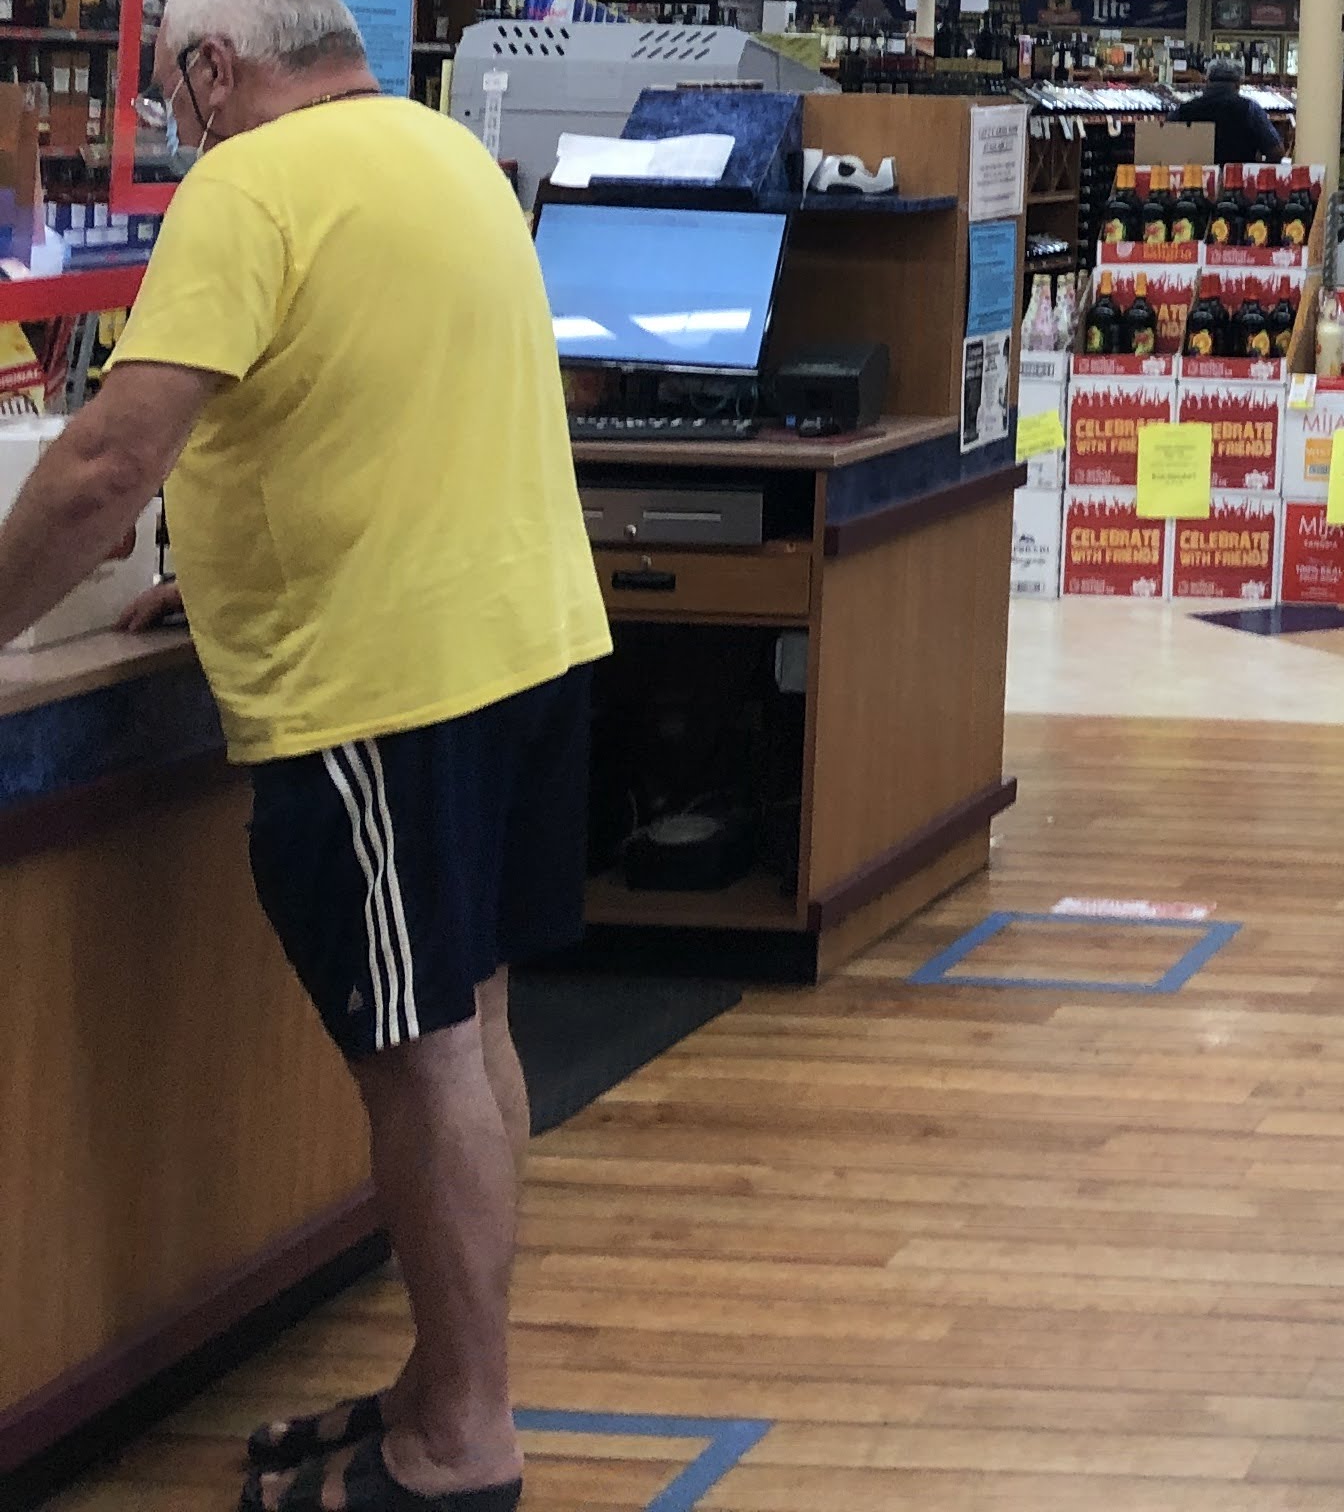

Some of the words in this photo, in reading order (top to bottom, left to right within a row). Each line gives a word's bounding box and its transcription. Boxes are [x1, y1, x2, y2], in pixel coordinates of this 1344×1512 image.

[1076, 439, 1107, 455] WITH
[1218, 440, 1272, 457] FRIENDS
[1070, 527, 1160, 548] CELEBRATE
[1180, 530, 1270, 550] CELEBRATE
[1071, 548, 1102, 565] WITH
[1105, 548, 1159, 565] FRIENDS
[1180, 550, 1211, 566] WITH
[1214, 550, 1269, 567] FRIENDS
